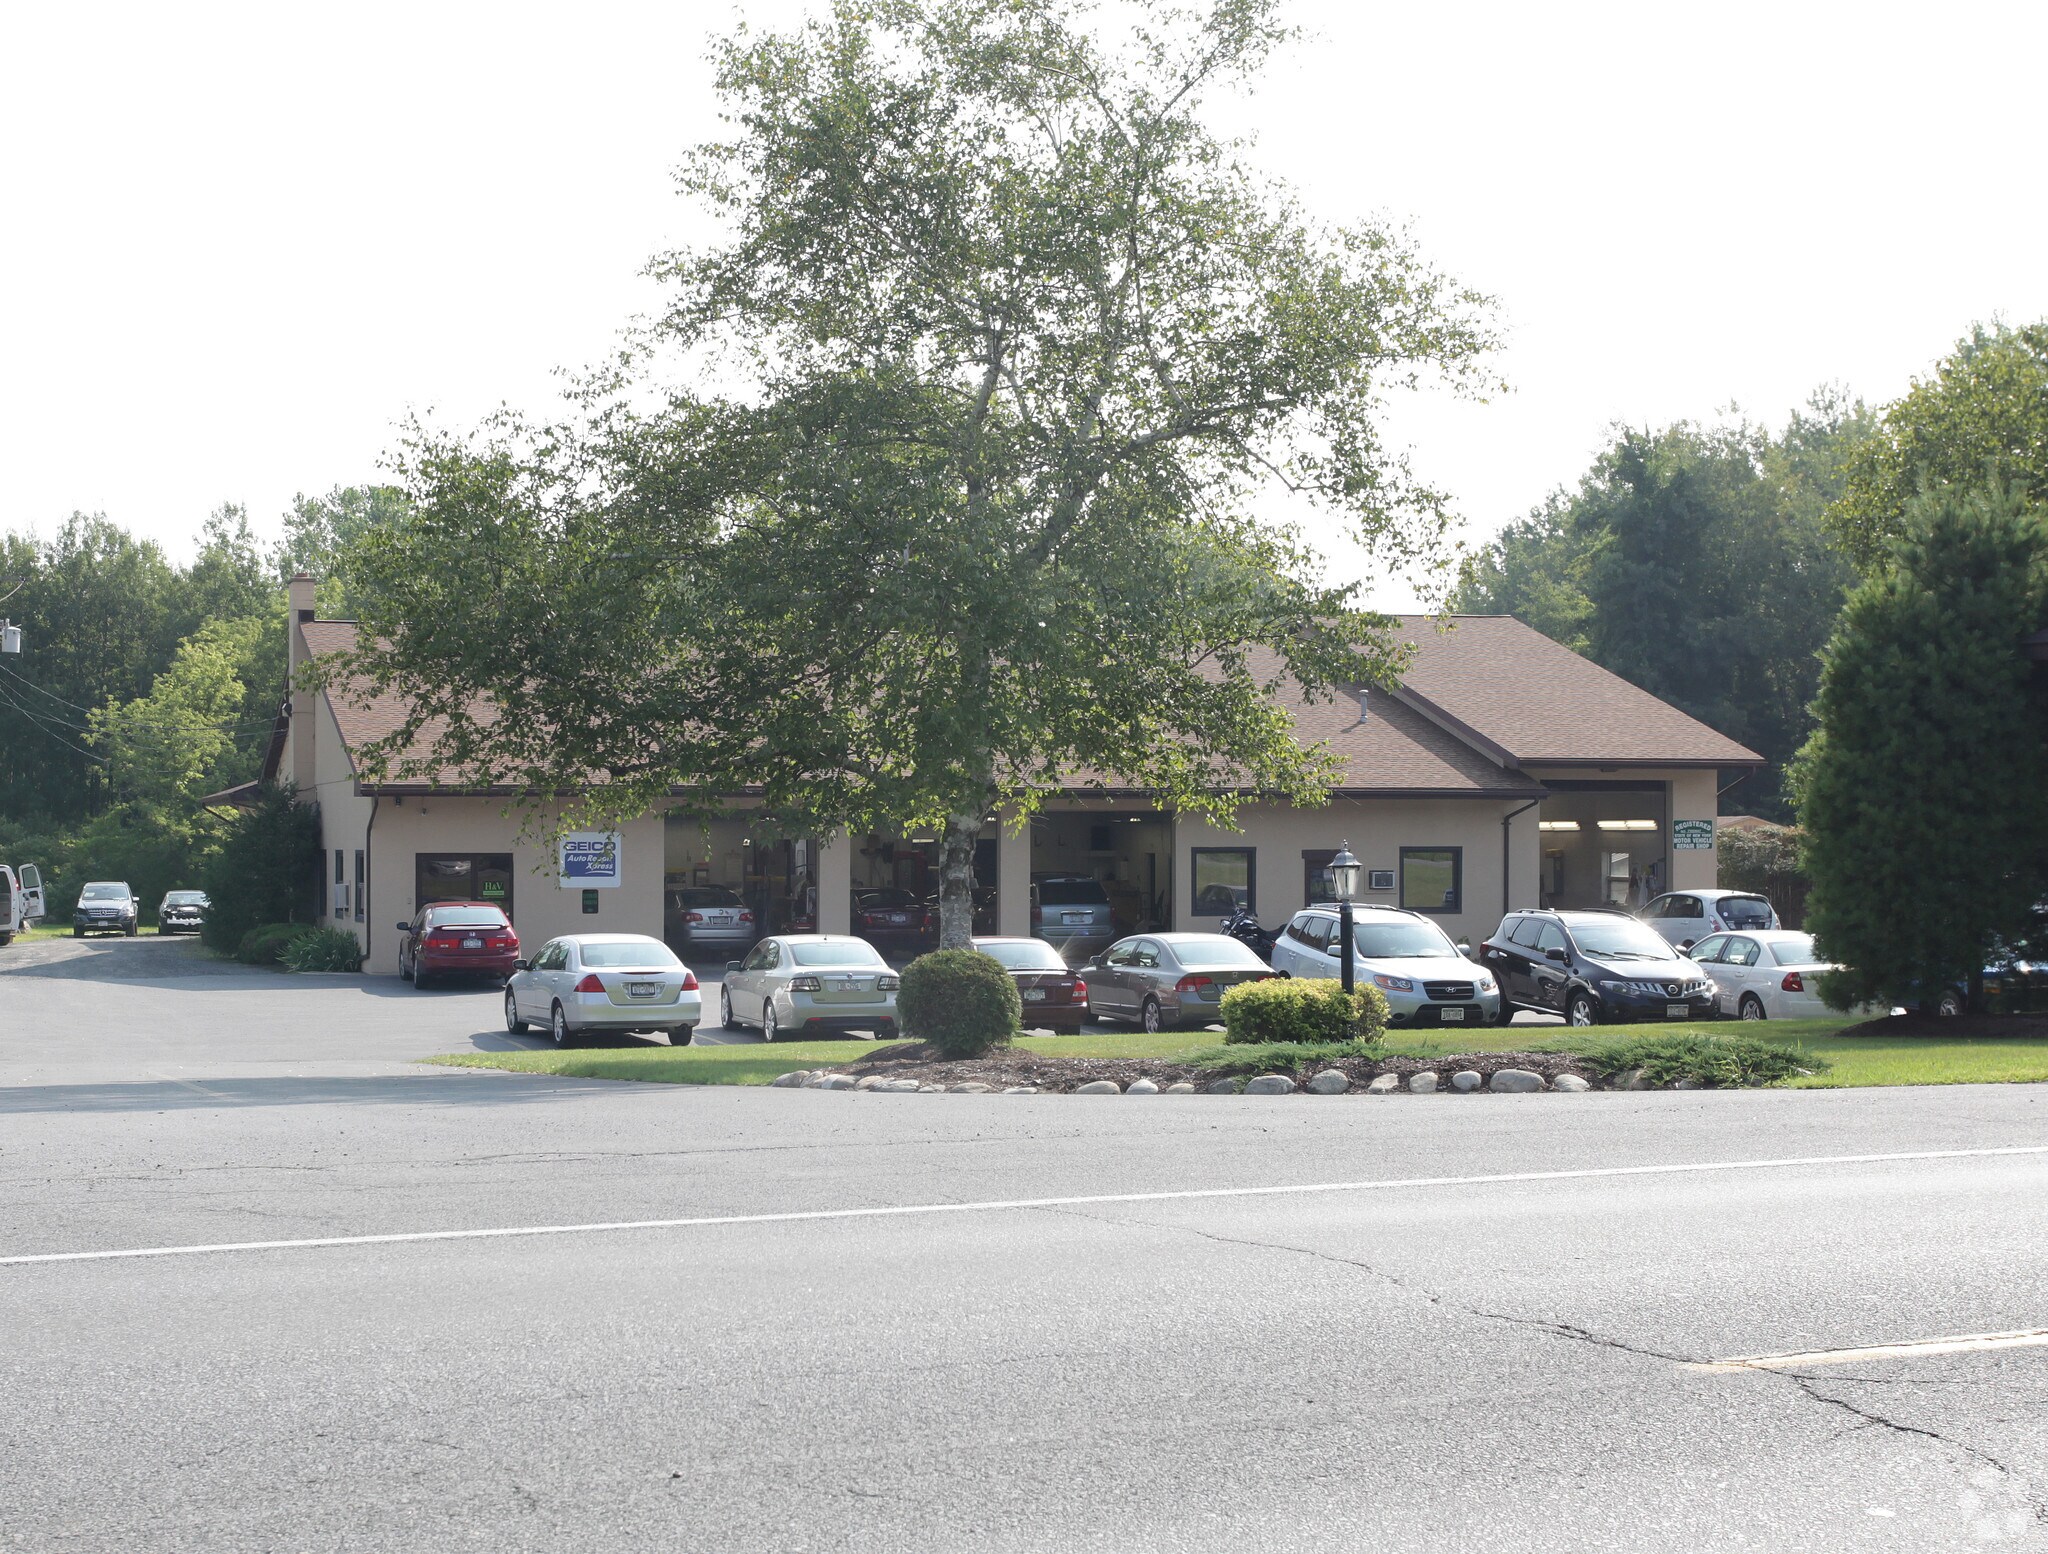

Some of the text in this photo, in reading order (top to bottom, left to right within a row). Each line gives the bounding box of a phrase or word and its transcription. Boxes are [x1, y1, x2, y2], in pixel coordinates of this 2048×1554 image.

[1675, 821, 1711, 831] REGISTERED
[565, 842, 616, 851] GEICO
[585, 862, 614, 870] Xpress
[485, 882, 503, 890] H&V
